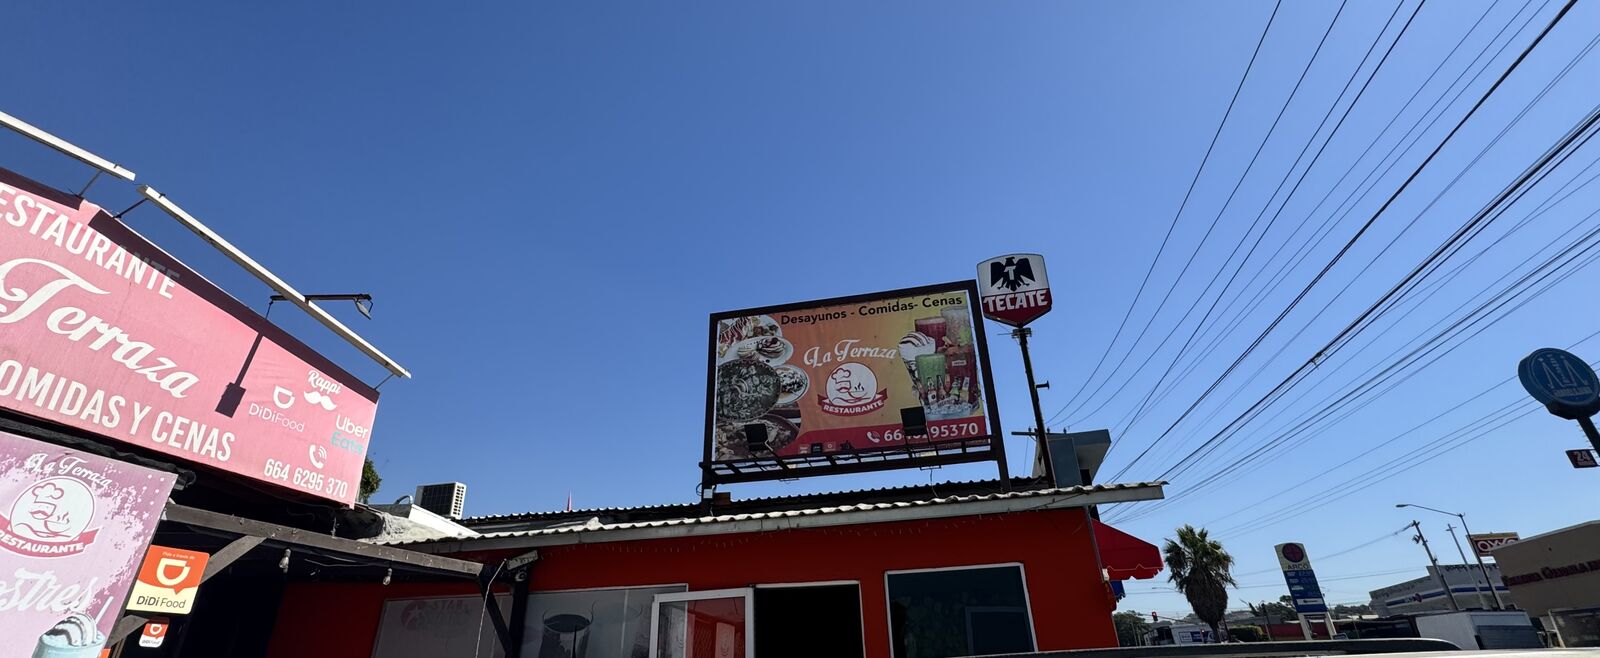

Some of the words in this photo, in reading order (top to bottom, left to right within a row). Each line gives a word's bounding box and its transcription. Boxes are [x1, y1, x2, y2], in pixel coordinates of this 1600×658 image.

[780, 311, 847, 325] Desayunos
[922, 296, 962, 308] Cenas
[982, 289, 1049, 313] TECATE
[0, 258, 200, 398] Terraza
[803, 346, 831, 368] La
[834, 339, 898, 362] Terraza
[307, 370, 343, 395] Rappi
[823, 400, 884, 414] RESTAURANTE
[130, 401, 152, 435] Y
[151, 411, 235, 462] CENAS
[335, 414, 368, 439] Uber
[884, 422, 978, 441] 6695370
[330, 431, 363, 455] Eats
[58, 456, 112, 487] Terraza
[264, 458, 290, 481] 664
[293, 467, 324, 491] 6295
[326, 477, 348, 498] 370
[0, 568, 98, 612] stres
